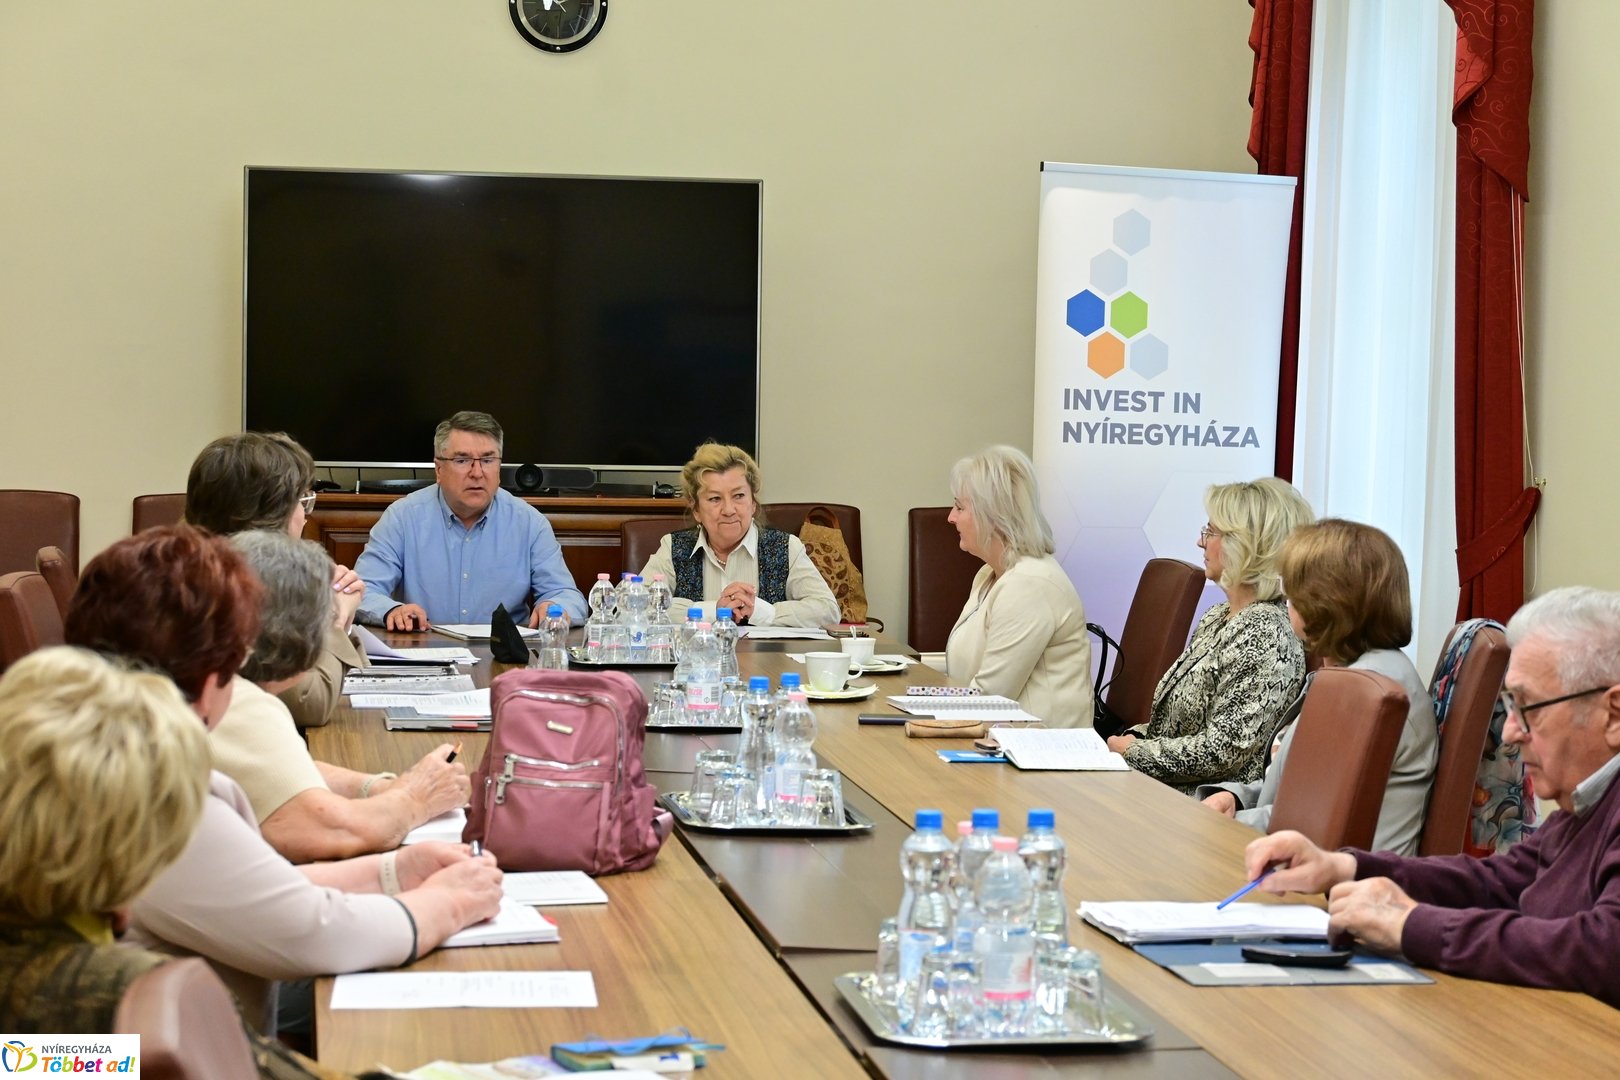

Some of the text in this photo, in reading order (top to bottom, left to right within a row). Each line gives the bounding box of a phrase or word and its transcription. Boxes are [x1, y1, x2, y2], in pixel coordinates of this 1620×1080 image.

[1063, 388, 1201, 414] INVEST IN
[1062, 417, 1260, 448] NYÍREGYHÁZA
